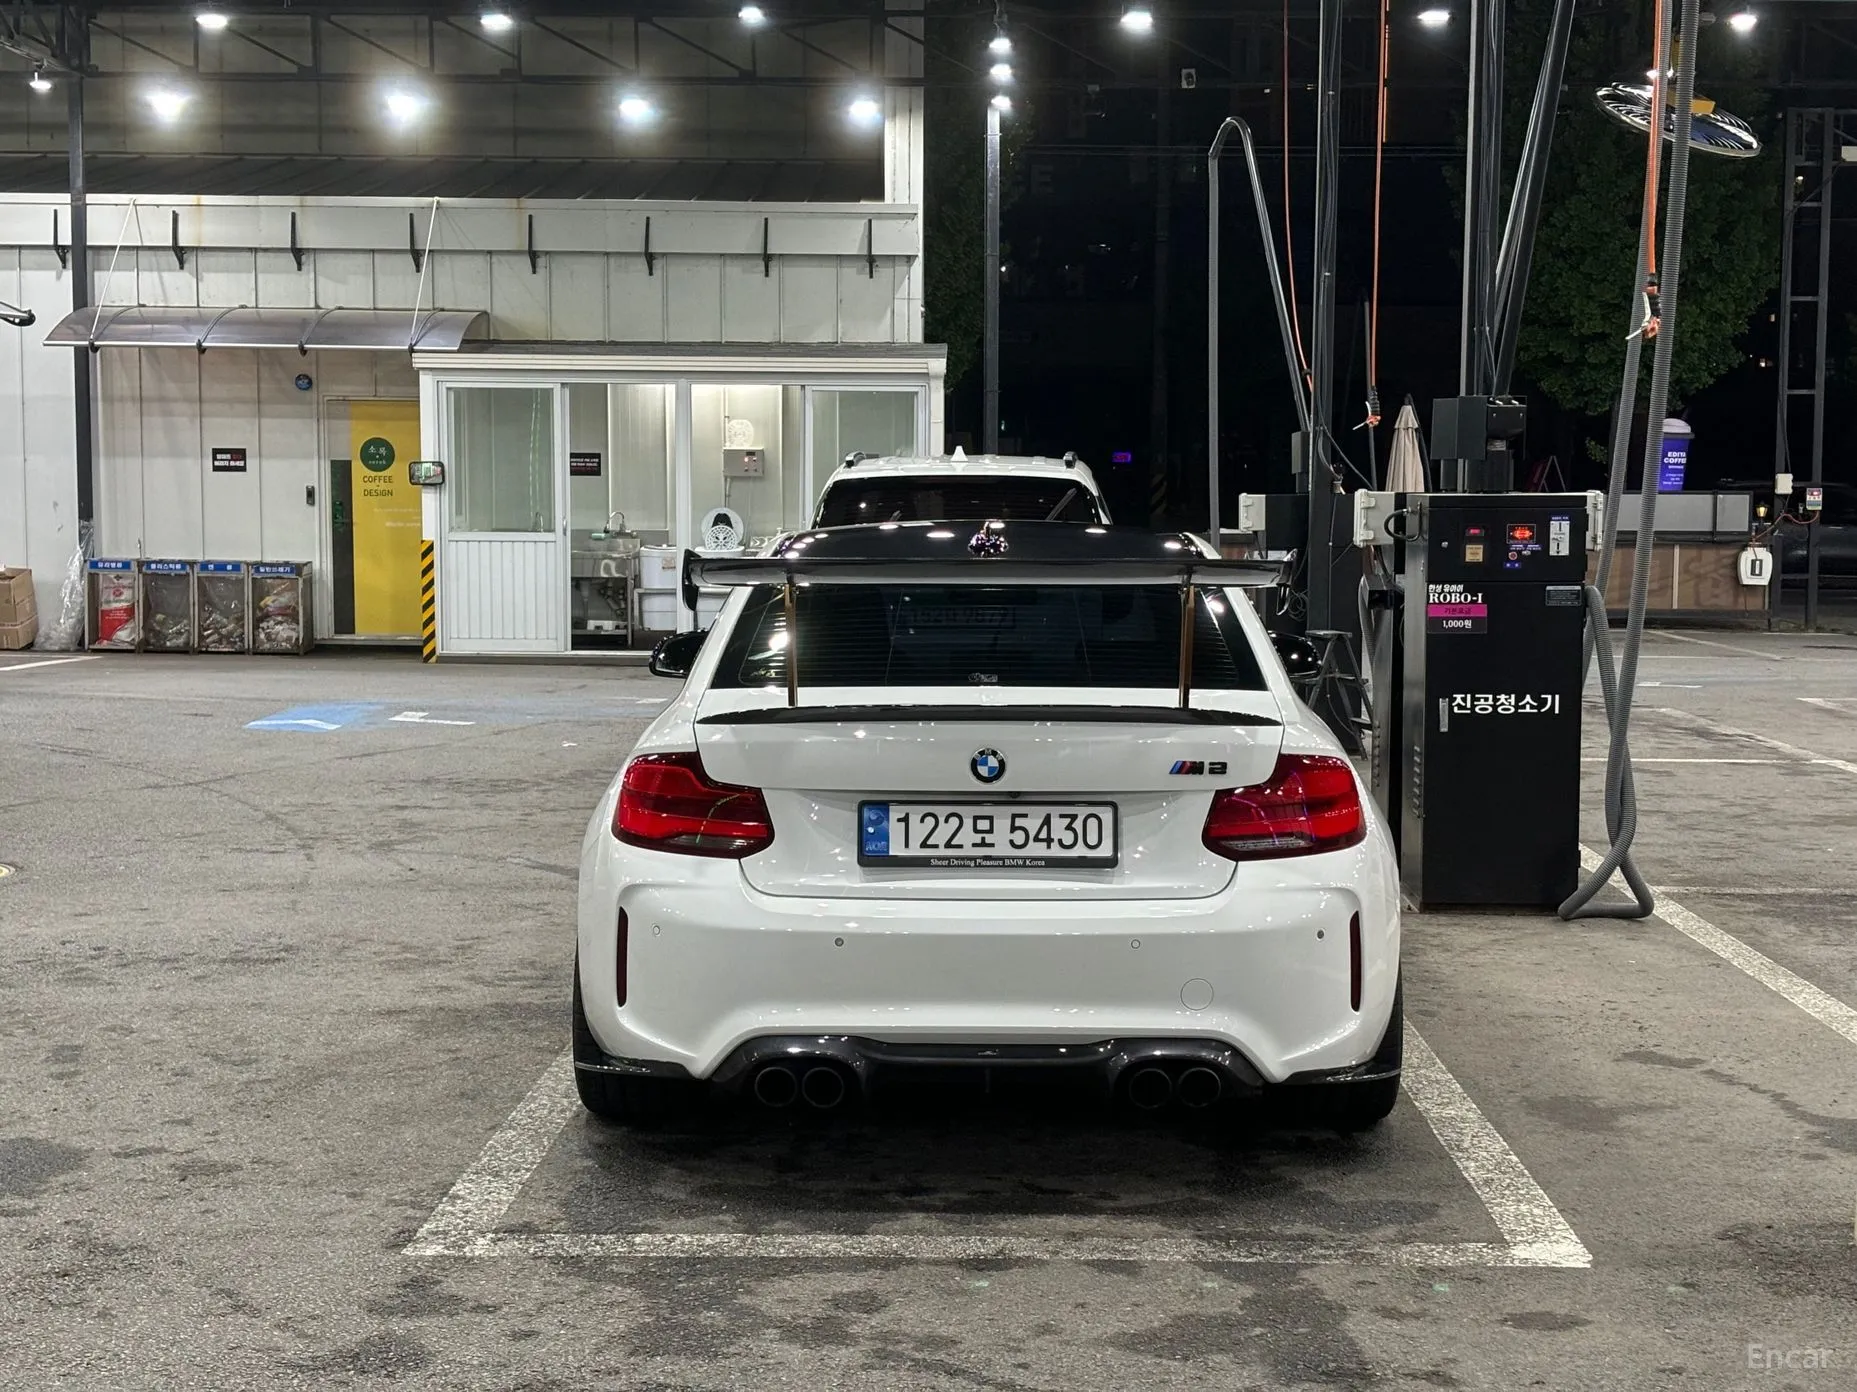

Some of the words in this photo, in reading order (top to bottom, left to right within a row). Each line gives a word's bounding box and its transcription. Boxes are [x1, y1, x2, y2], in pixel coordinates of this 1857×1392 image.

[362, 475, 393, 483] COFFEE
[363, 489, 393, 497] DESIGN
[1428, 593, 1483, 604] ROBO-I
[1442, 619, 1472, 629] 1,000원
[1452, 694, 1560, 714] 진공청소기
[896, 812, 995, 850] 122모
[1008, 813, 1103, 850] 5430
[950, 858, 975, 867] Driving
[976, 858, 1003, 866] Pleasure
[1004, 858, 1024, 866] BMW
[1025, 858, 1046, 866] Korea
